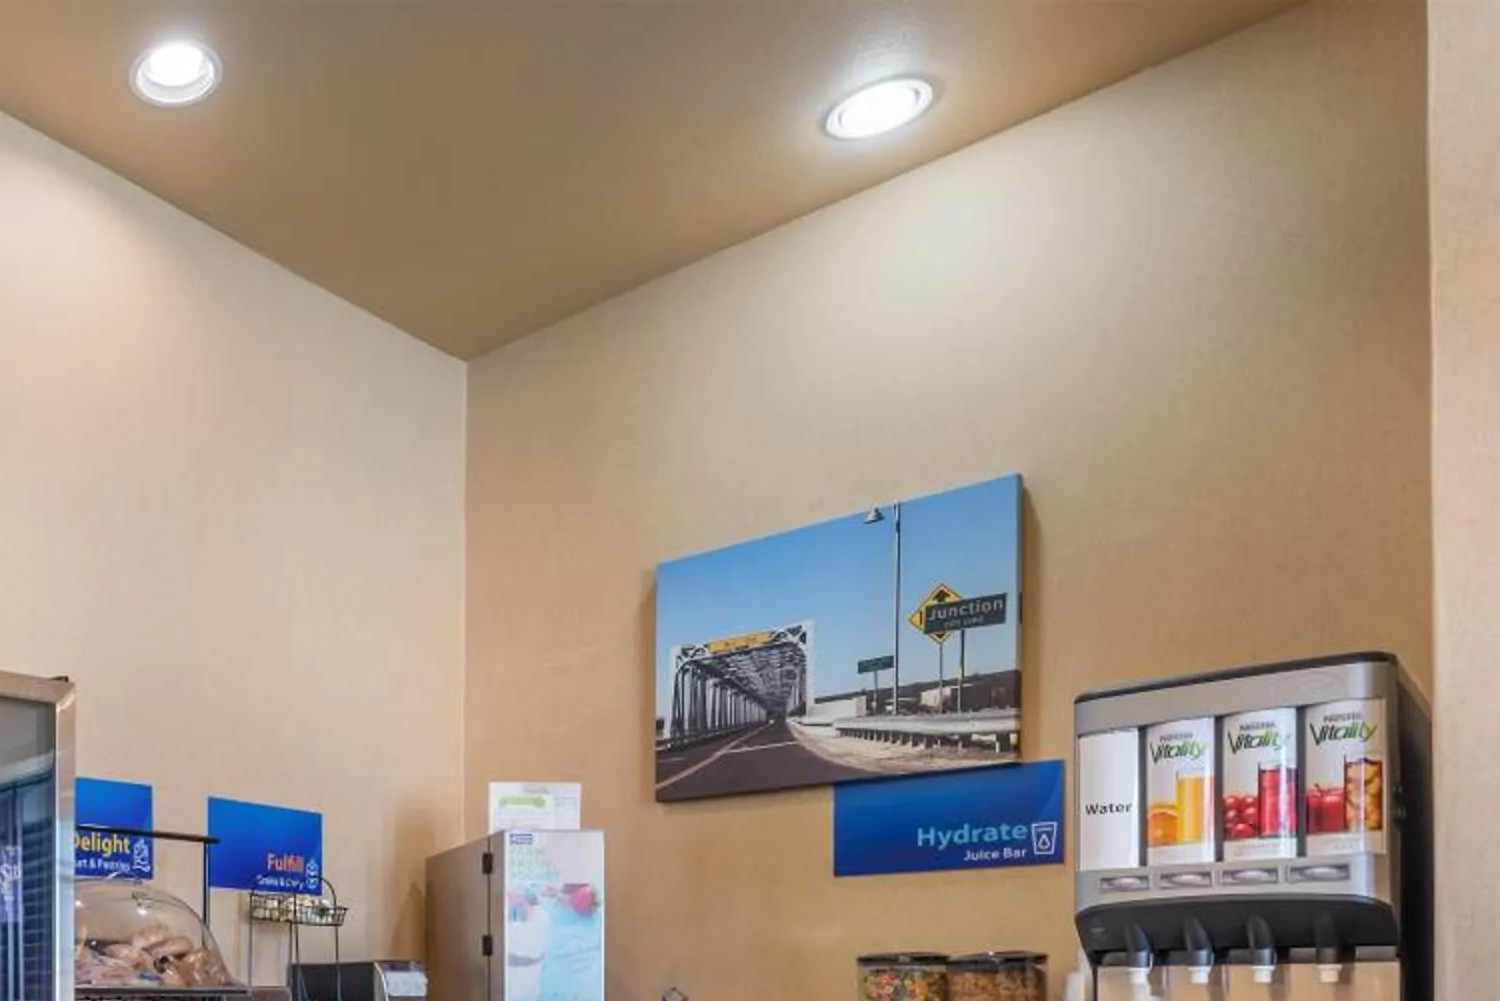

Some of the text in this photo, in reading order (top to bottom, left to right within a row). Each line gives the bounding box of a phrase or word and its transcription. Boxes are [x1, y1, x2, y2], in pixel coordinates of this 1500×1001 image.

[928, 599, 1004, 621] Junction
[1227, 728, 1293, 755] Vitality
[1309, 721, 1379, 746] Vitality
[1149, 739, 1207, 765] Vitality
[1085, 803, 1133, 816] Water
[917, 822, 1029, 850] Hydrate
[963, 847, 1028, 862] Juice Bar
